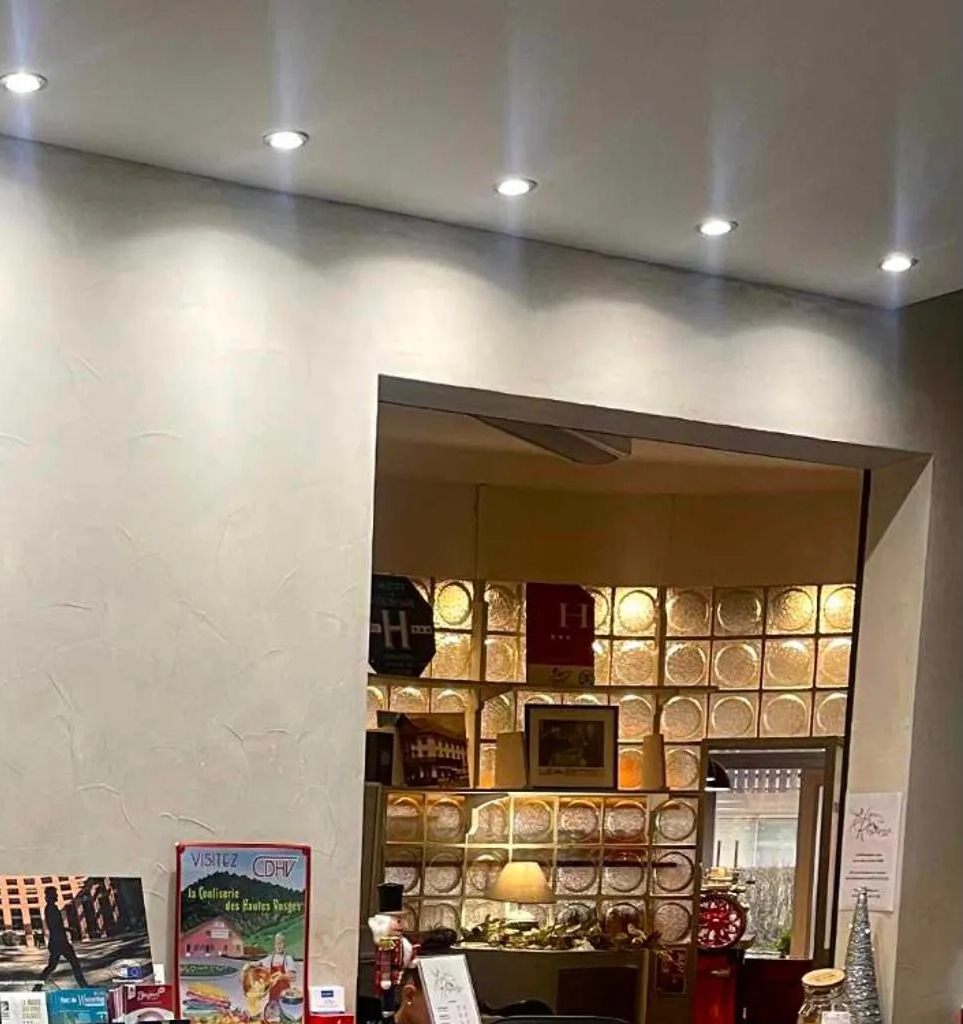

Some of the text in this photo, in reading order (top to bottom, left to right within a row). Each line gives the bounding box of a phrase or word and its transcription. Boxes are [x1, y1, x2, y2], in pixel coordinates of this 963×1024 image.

[559, 602, 589, 629] H
[190, 852, 238, 868] VISITEZ
[225, 898, 303, 913] des Hautes Vosges
